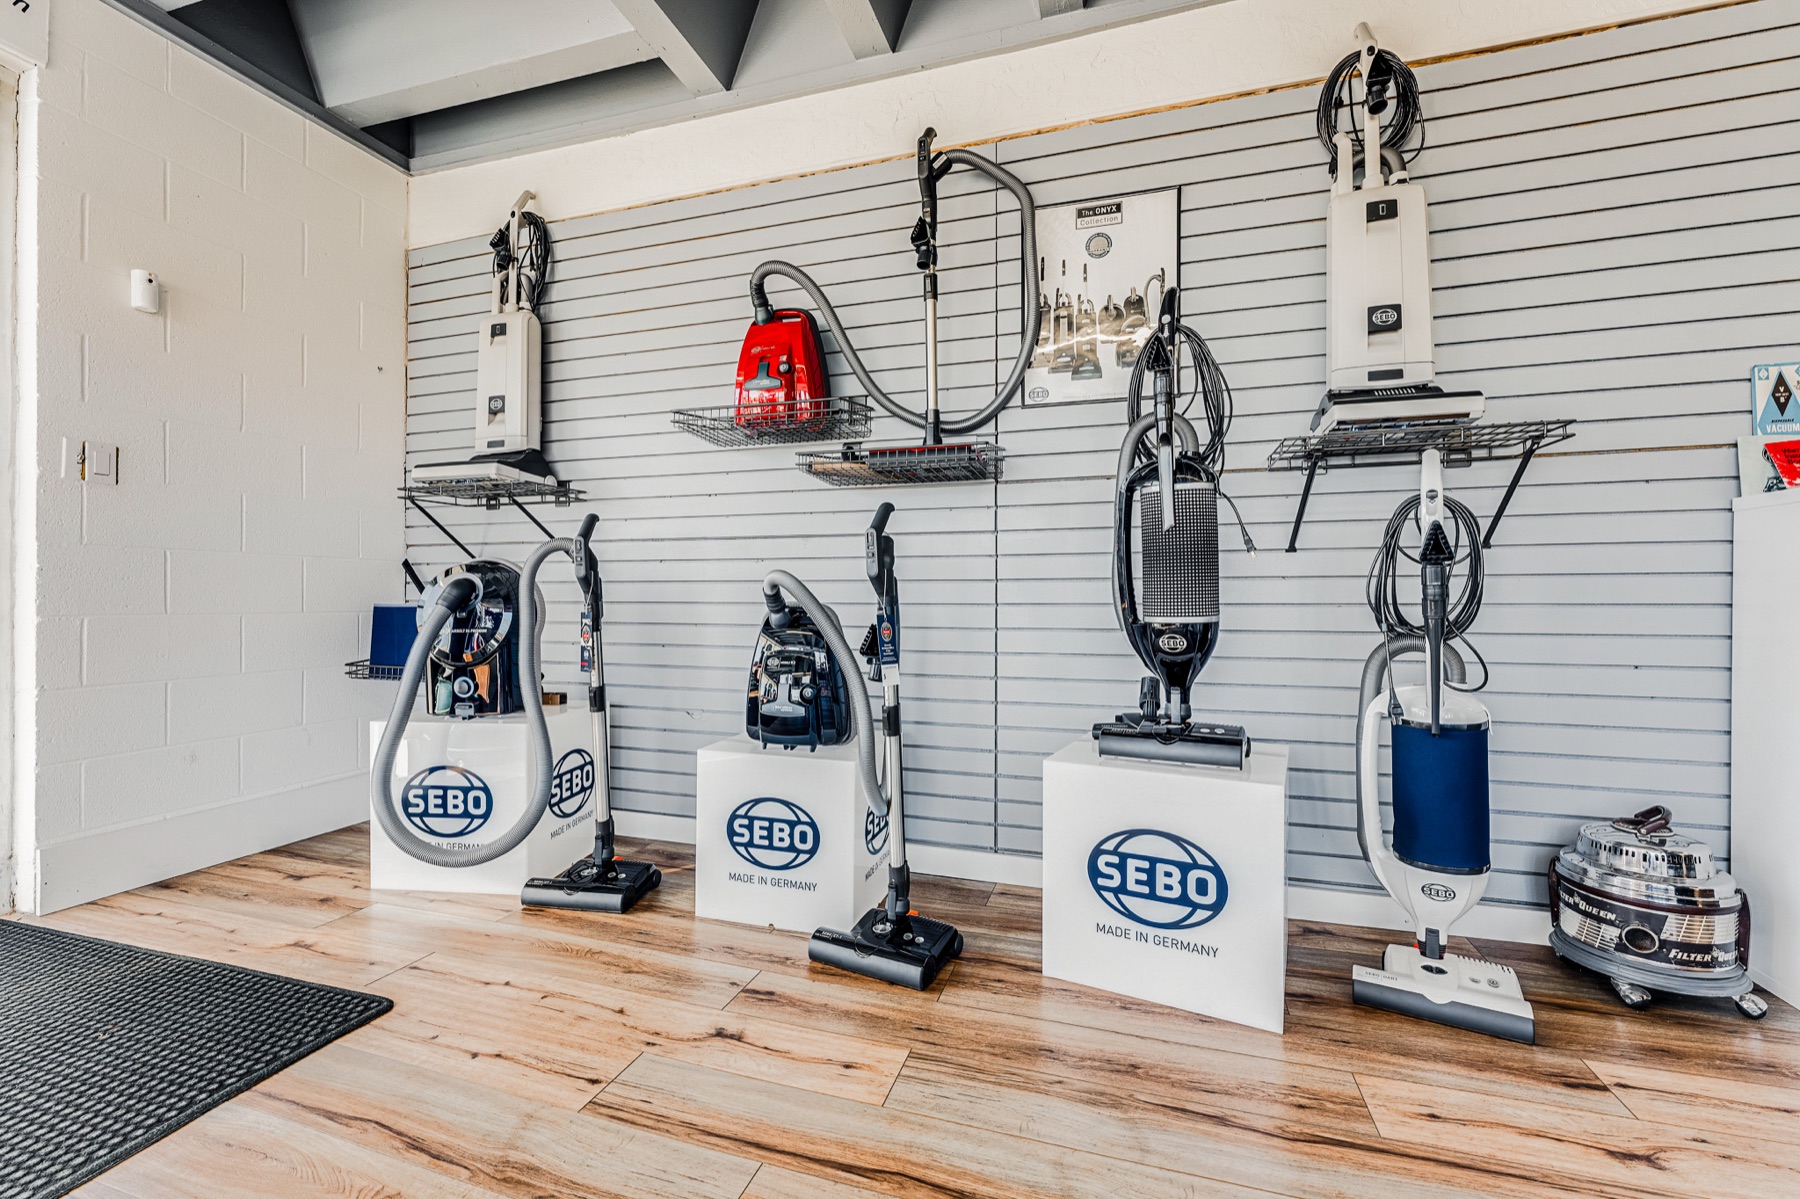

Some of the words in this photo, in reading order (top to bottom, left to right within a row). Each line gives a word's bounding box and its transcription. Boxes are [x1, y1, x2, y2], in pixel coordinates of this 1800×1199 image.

[1095, 205, 1117, 215] ONYX
[1080, 216, 1119, 226] Collection
[1374, 313, 1396, 321] SEBO
[1766, 422, 1800, 433] VACUUM
[1161, 639, 1185, 647] SEBO
[551, 764, 593, 805] SEBO
[407, 788, 487, 816] SEBO
[733, 818, 814, 851] SEBO
[728, 872, 755, 884] MADE
[757, 875, 768, 886] IN
[770, 877, 817, 892] GERMANY
[1097, 854, 1217, 905] SEBO
[1423, 886, 1455, 898] SEBO
[1579, 900, 1617, 921] QUEEN
[1096, 922, 1131, 940] MADE
[1135, 930, 1149, 944] IN
[1153, 934, 1219, 958] GERMANY
[1668, 948, 1712, 962] FILTER
